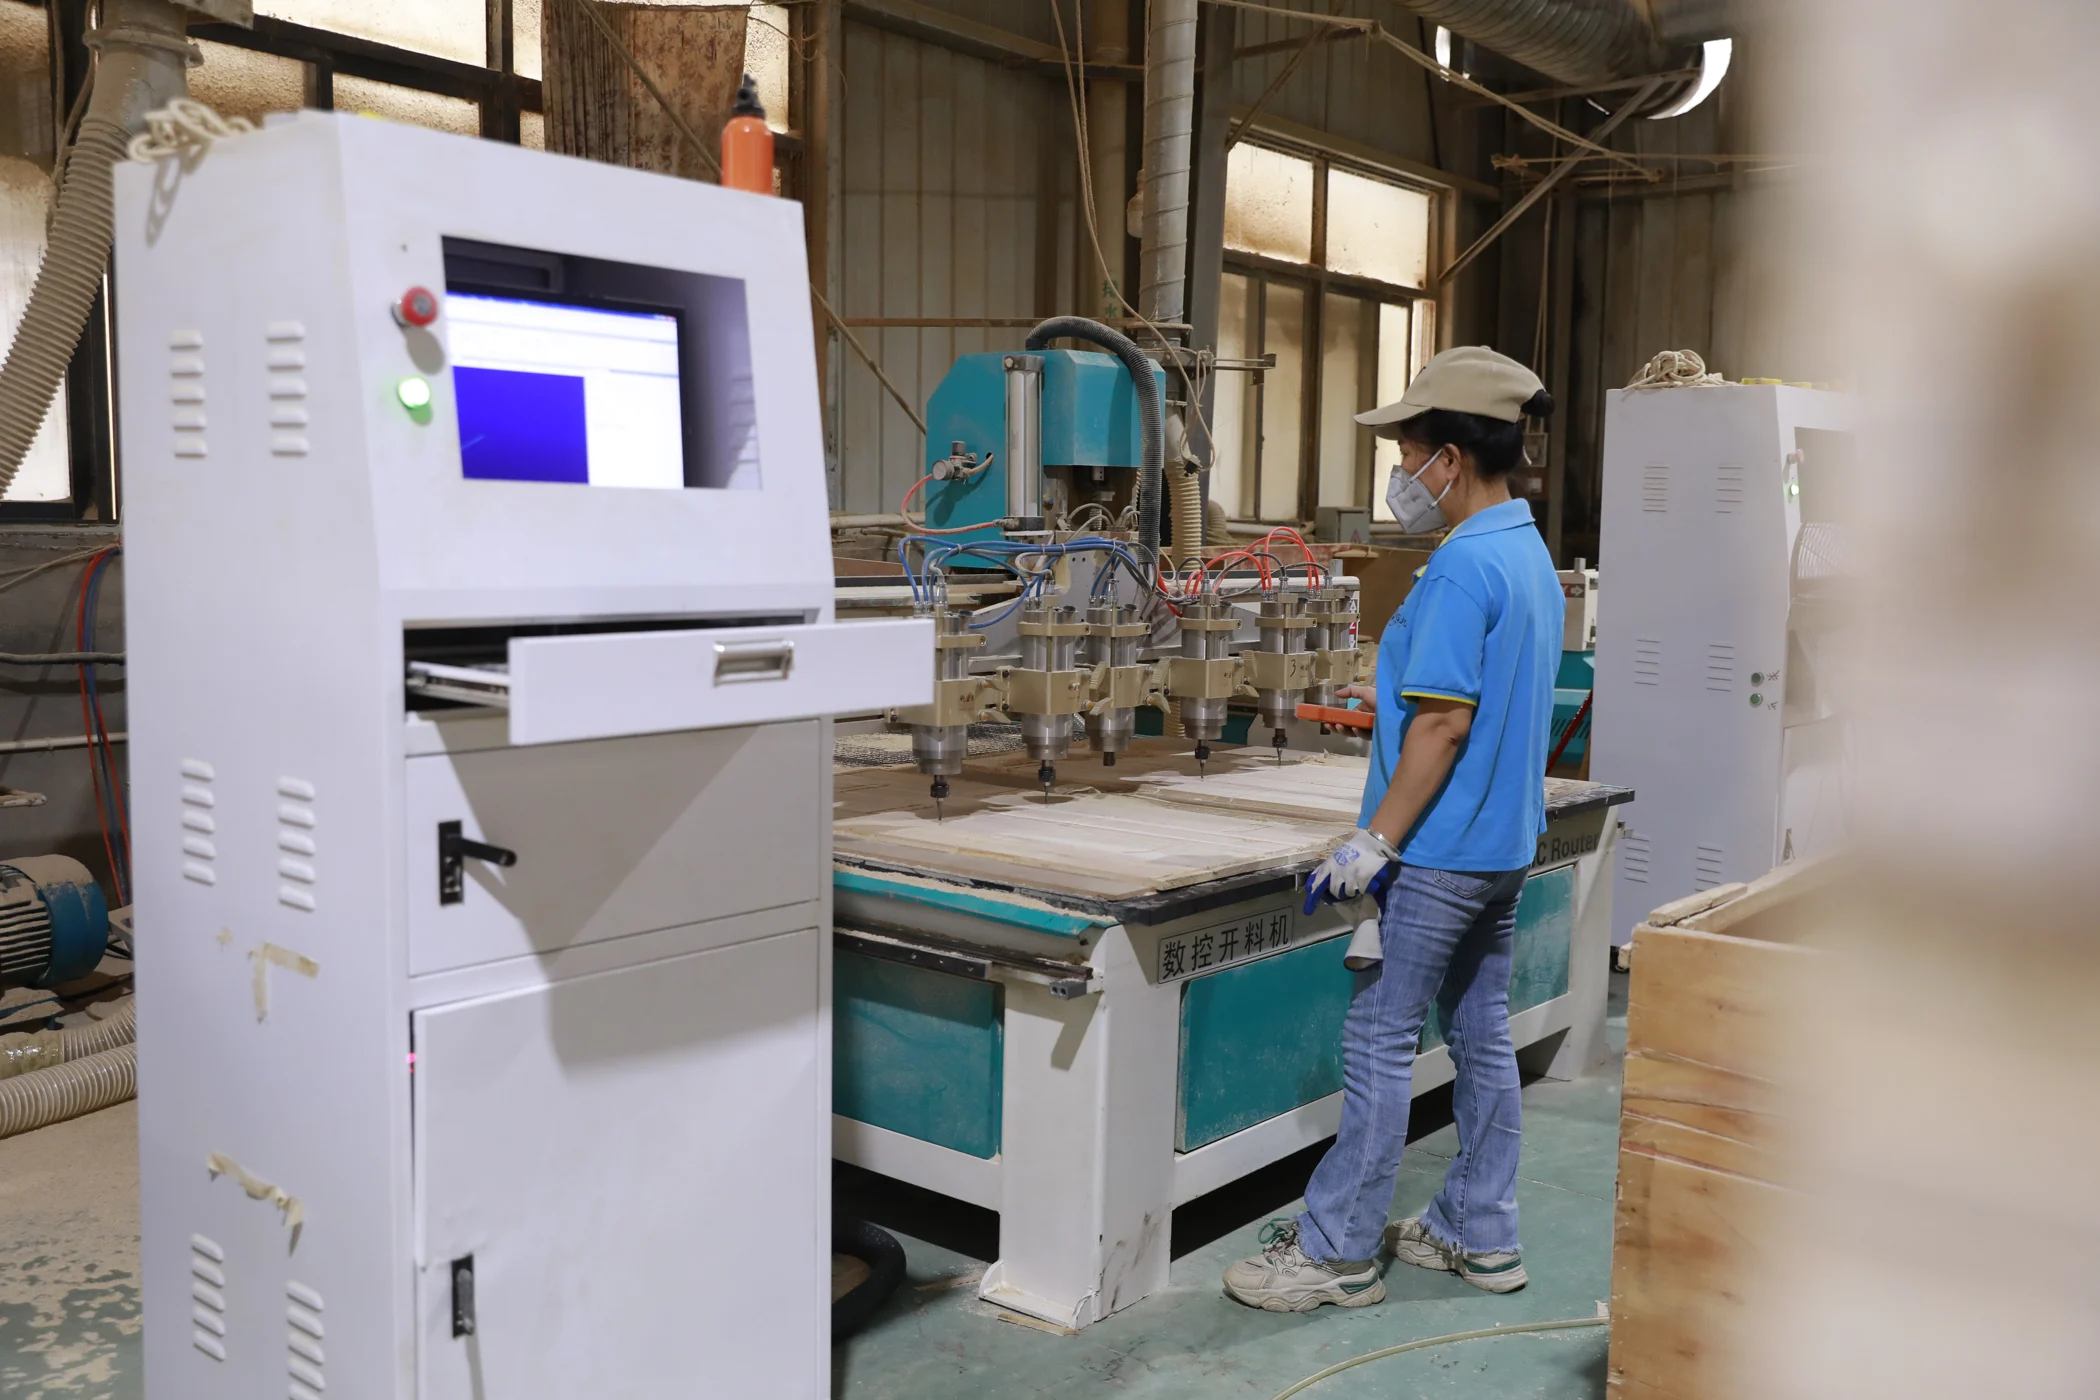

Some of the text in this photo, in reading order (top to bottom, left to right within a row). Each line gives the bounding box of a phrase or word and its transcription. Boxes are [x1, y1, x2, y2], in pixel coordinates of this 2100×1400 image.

[1530, 833, 1602, 868] C Router
[1162, 914, 1288, 979] 数控开料机
